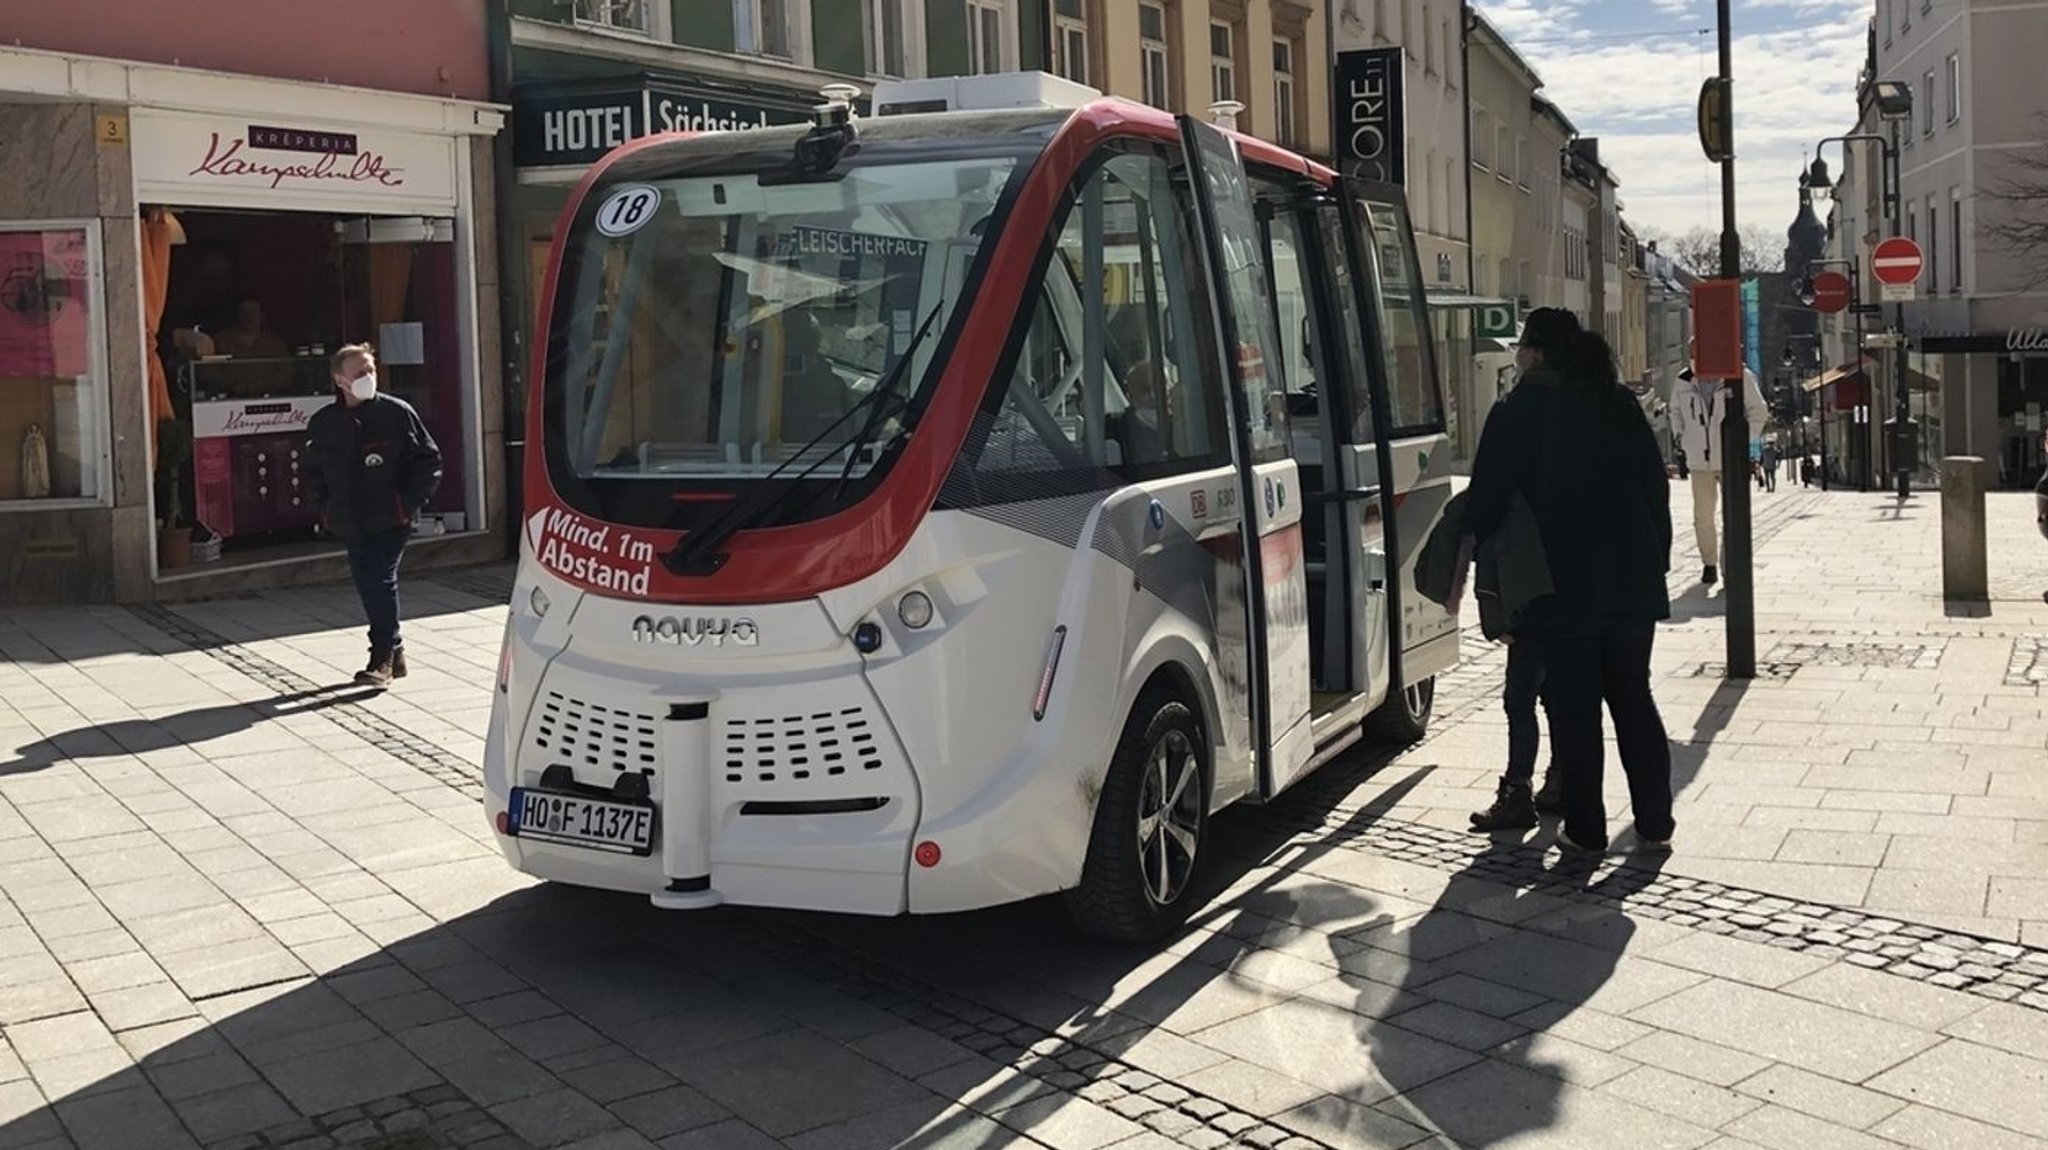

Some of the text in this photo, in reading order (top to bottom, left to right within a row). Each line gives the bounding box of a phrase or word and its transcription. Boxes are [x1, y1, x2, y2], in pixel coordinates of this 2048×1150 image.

[107, 120, 118, 137] 3
[544, 106, 631, 151] HOTEL
[610, 193, 650, 226] 18
[1484, 306, 1509, 331] D
[547, 508, 653, 563] Mind. 1m
[541, 538, 651, 596] Abstand
[632, 614, 759, 647] navya
[522, 795, 650, 844] HO F 1137E
